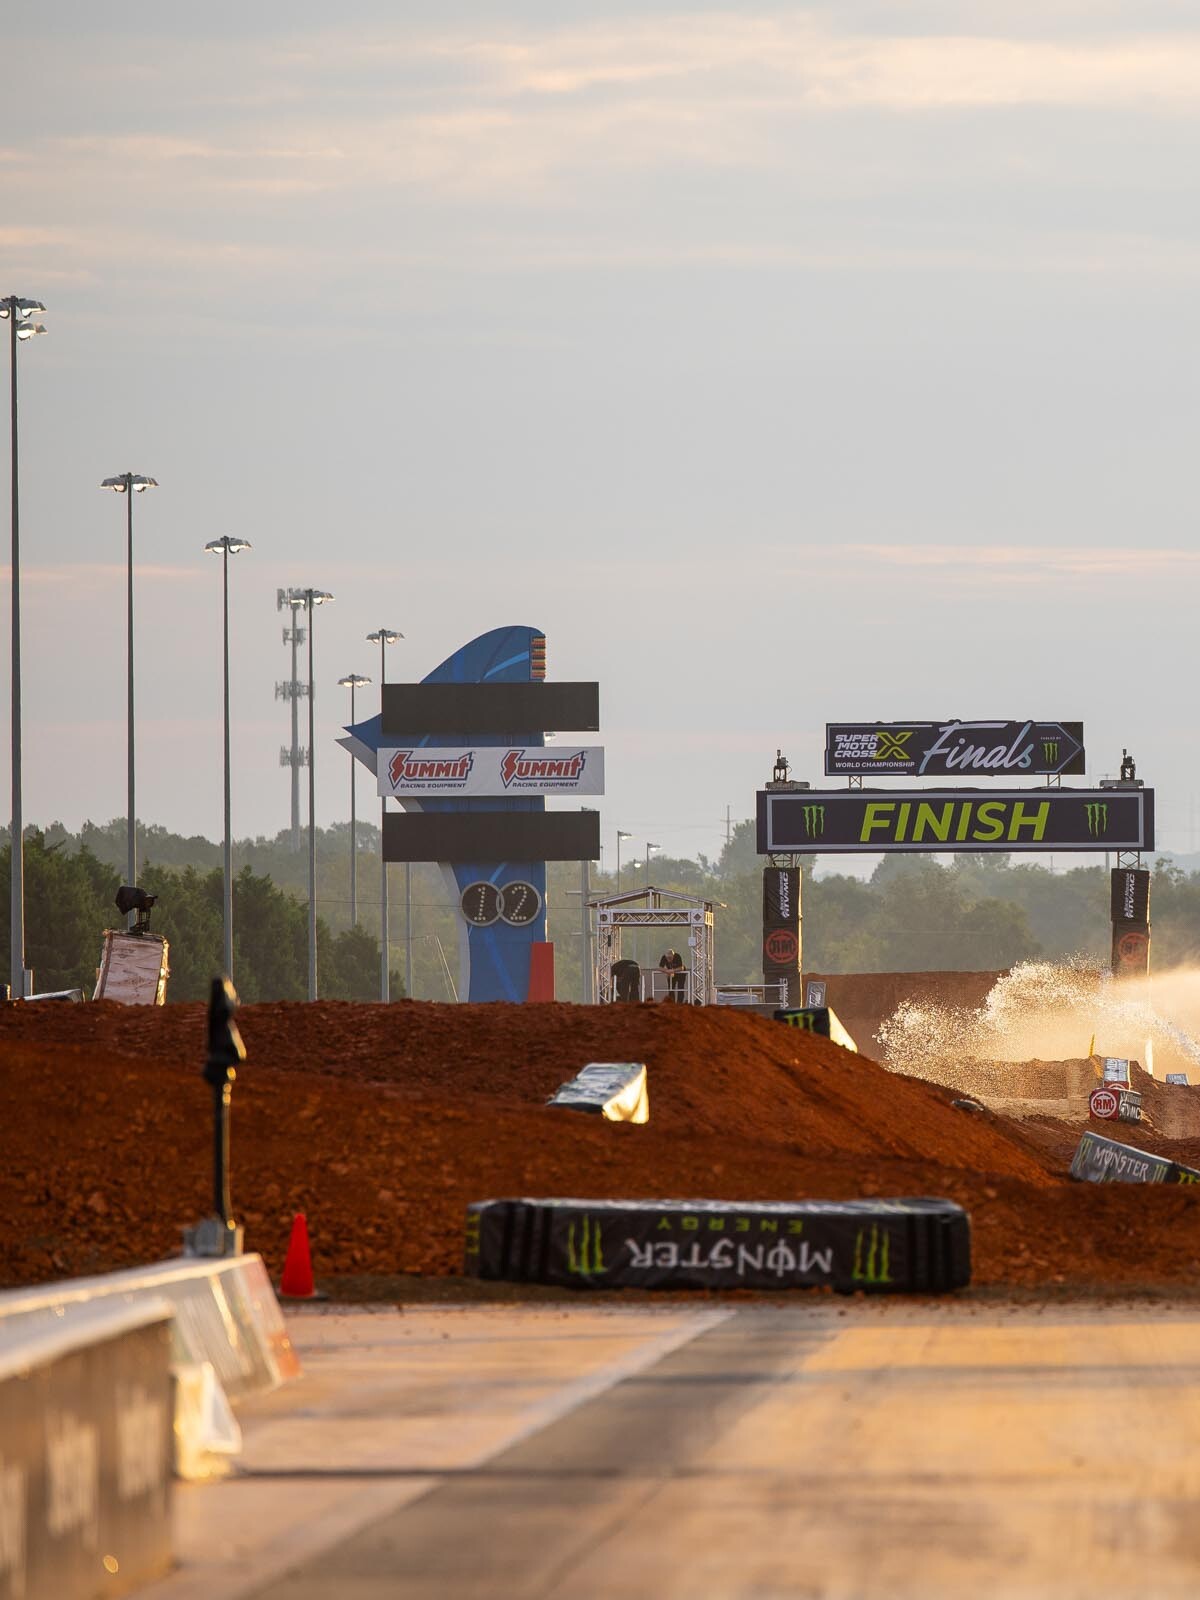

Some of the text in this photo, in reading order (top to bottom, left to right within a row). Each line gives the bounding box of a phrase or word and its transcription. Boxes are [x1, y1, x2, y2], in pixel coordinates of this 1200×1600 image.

[834, 750, 878, 758] CROSS
[835, 734, 878, 742] SUPER
[838, 742, 877, 750] MOTO
[918, 722, 1035, 774] Finals
[859, 801, 1050, 842] FINISH
[510, 885, 527, 921] 2
[1093, 1146, 1150, 1182] MONSTER
[657, 1215, 803, 1234] ENERGY
[624, 1236, 833, 1277] MONSTER
